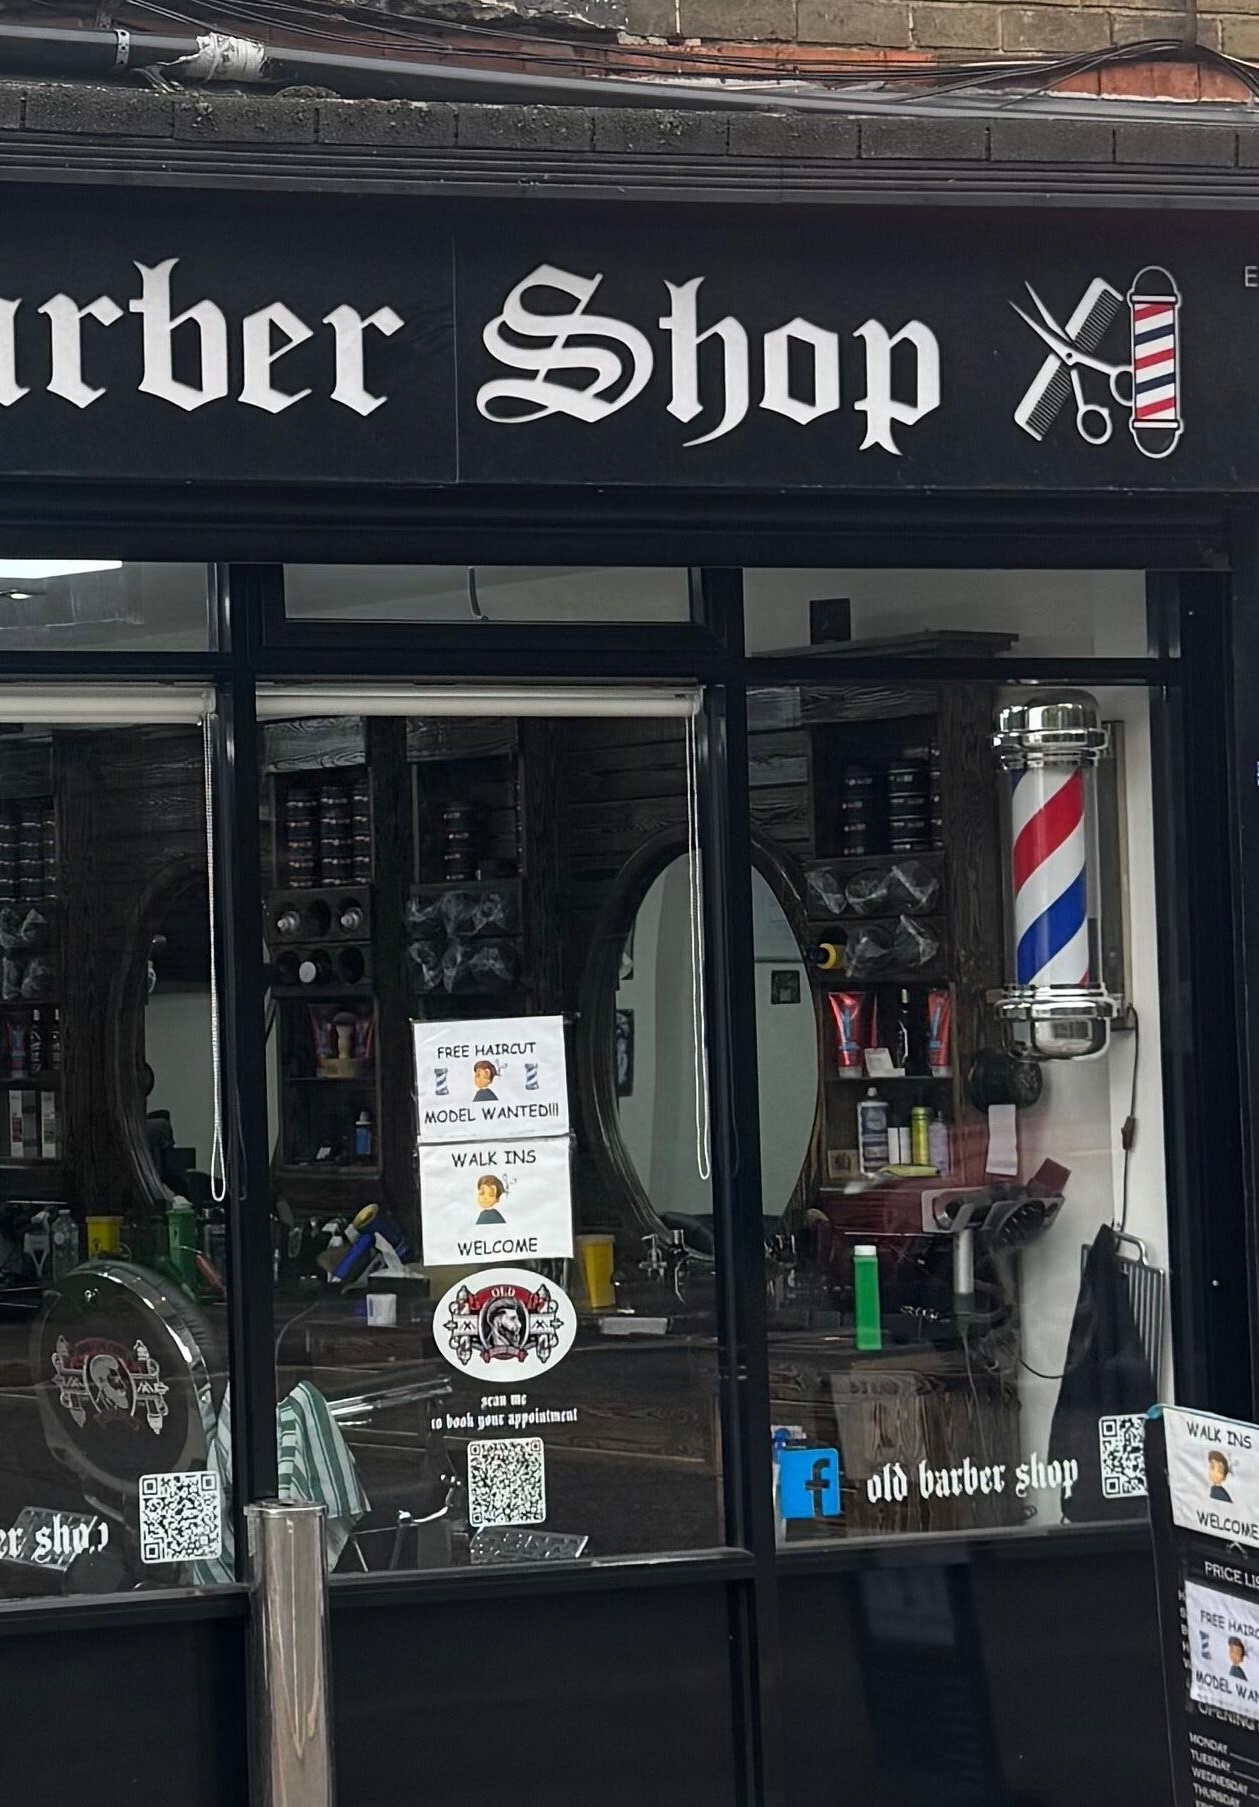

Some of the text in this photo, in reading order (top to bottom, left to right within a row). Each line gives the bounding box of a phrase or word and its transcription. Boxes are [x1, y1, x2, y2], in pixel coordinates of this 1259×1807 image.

[475, 263, 941, 457] Shop
[437, 1041, 537, 1059] FREE HAIRCUT
[424, 1102, 559, 1124] MODEL WANTED!!!
[452, 1149, 537, 1168] WALK INS
[457, 1237, 538, 1256] WELCOME
[491, 1286, 516, 1297] OLD
[480, 1393, 527, 1410] scan me
[446, 1412, 475, 1429] book
[477, 1413, 505, 1431] your
[508, 1407, 578, 1429] appointment
[1186, 1421, 1253, 1449] WALK INS
[866, 1451, 1079, 1504] old barber shop
[1196, 1509, 1259, 1541] WELCOME
[1204, 1560, 1243, 1585] PRICE
[1200, 1609, 1226, 1630] FREE
[1195, 1669, 1233, 1695] MODEL
[1188, 1731, 1228, 1755] MONDAY
[1190, 1748, 1231, 1773] TUESDAY
[1191, 1766, 1248, 1795] WEDNESDAY
[1192, 1782, 1240, 1807] THURSDAY
